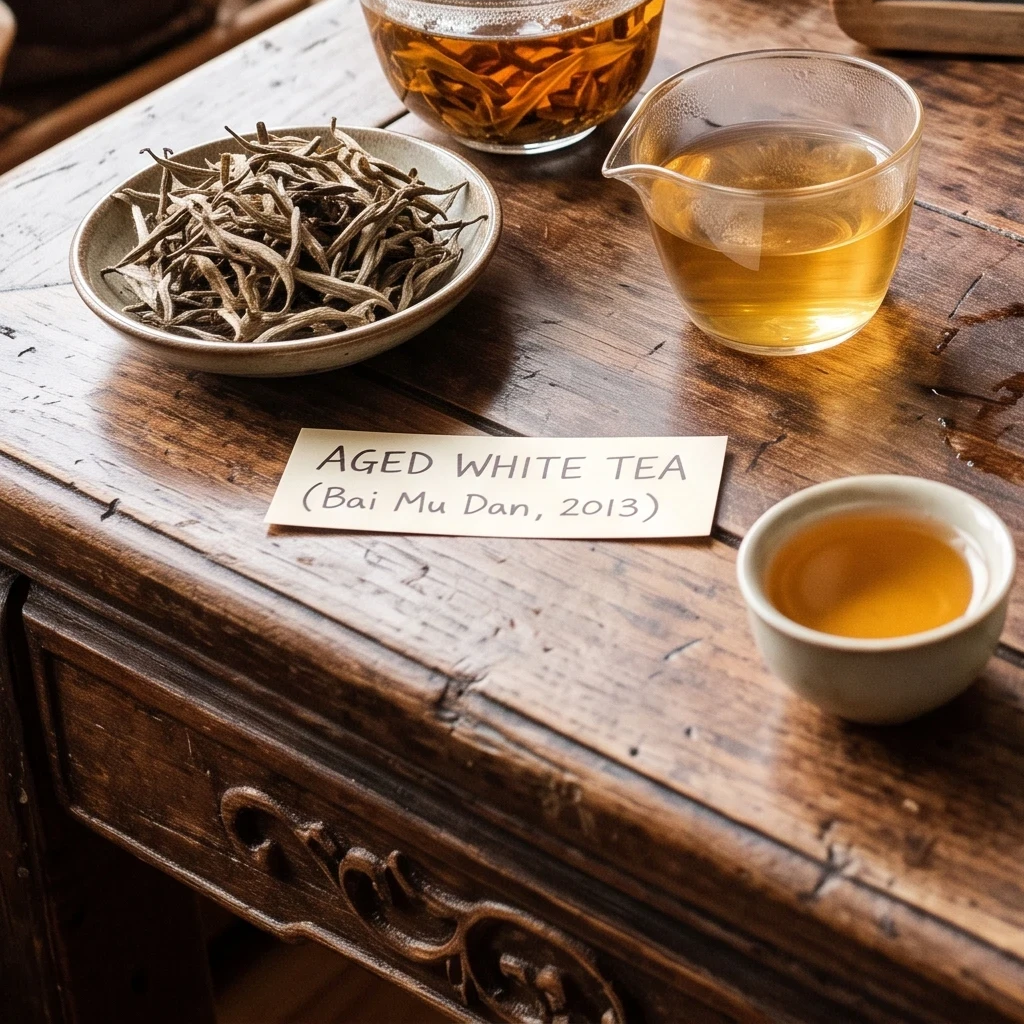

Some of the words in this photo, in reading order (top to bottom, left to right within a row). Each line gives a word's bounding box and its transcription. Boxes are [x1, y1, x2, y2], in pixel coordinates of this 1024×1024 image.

[316, 445, 434, 475] AGED
[456, 452, 587, 480] WHITE
[606, 454, 687, 481] TEA
[301, 481, 377, 512] (Bai
[393, 491, 446, 515] Mu
[463, 493, 543, 522] Dan,
[560, 492, 660, 524] 2013)
